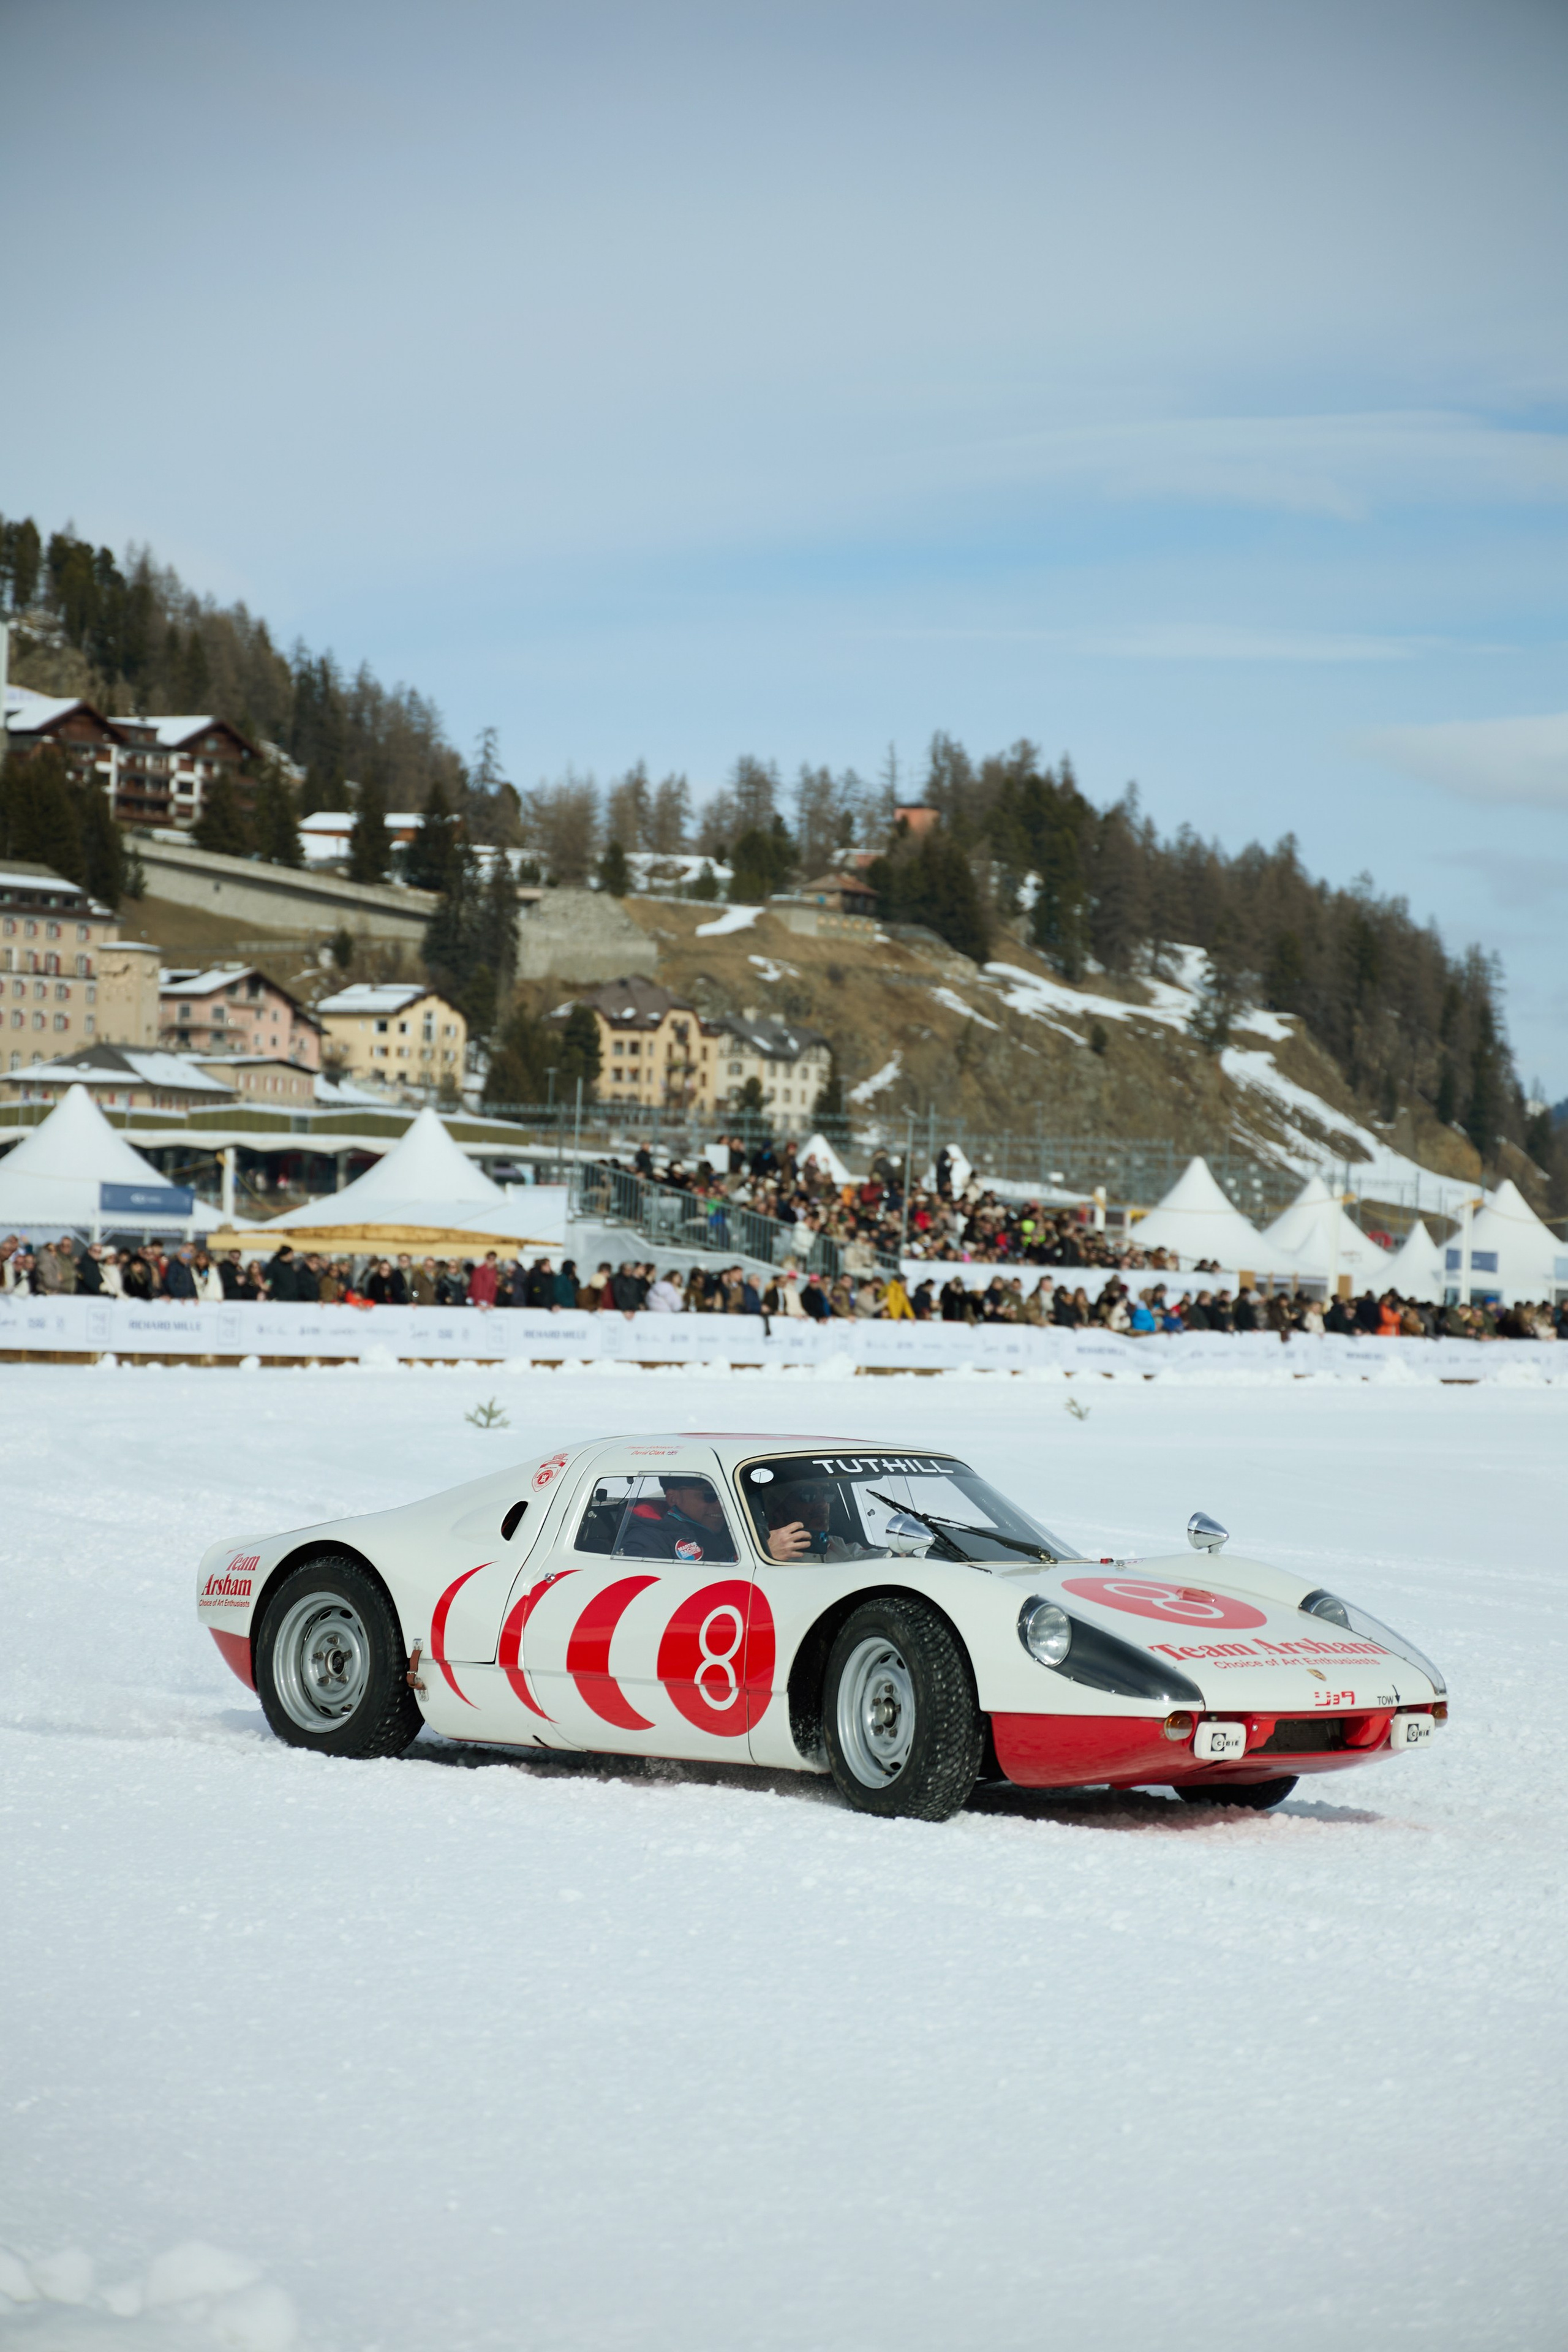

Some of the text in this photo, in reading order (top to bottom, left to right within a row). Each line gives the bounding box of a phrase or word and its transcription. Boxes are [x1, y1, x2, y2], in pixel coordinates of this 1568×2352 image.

[812, 1458, 954, 1474] TUTHILL
[225, 1553, 260, 1571] Team
[201, 1573, 252, 1596] Arsham
[1103, 1583, 1225, 1619] 8
[694, 1605, 744, 1711] 8
[1147, 1638, 1392, 1661] Team Arsham
[1213, 1660, 1264, 1669] Choice
[1378, 1696, 1393, 1705] TOW
